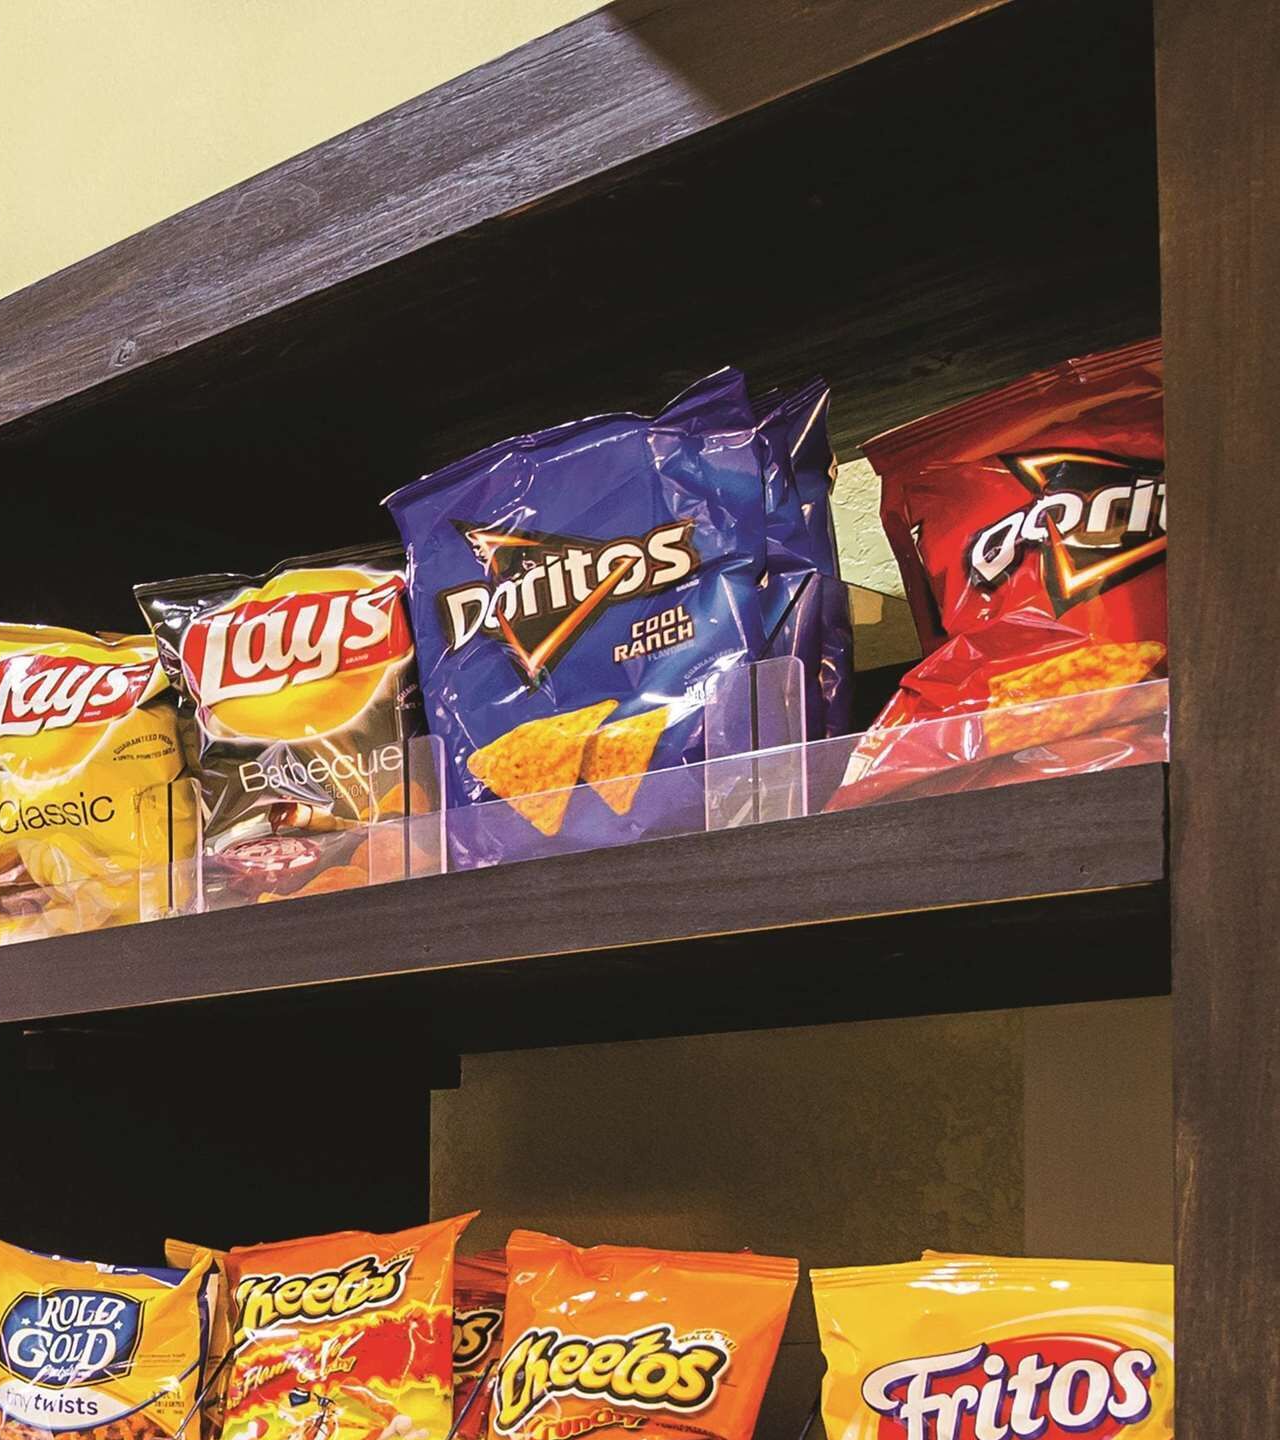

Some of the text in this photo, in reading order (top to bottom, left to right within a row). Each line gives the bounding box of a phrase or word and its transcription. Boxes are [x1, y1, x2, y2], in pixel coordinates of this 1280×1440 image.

[446, 522, 696, 652] Doritos
[613, 621, 694, 663] RANCH
[631, 605, 690, 640] COOL
[40, 1293, 126, 1329] ROLD
[6, 1326, 118, 1374] GOLD
[496, 1328, 726, 1430] Cheetos
[33, 1391, 99, 1416] twists
